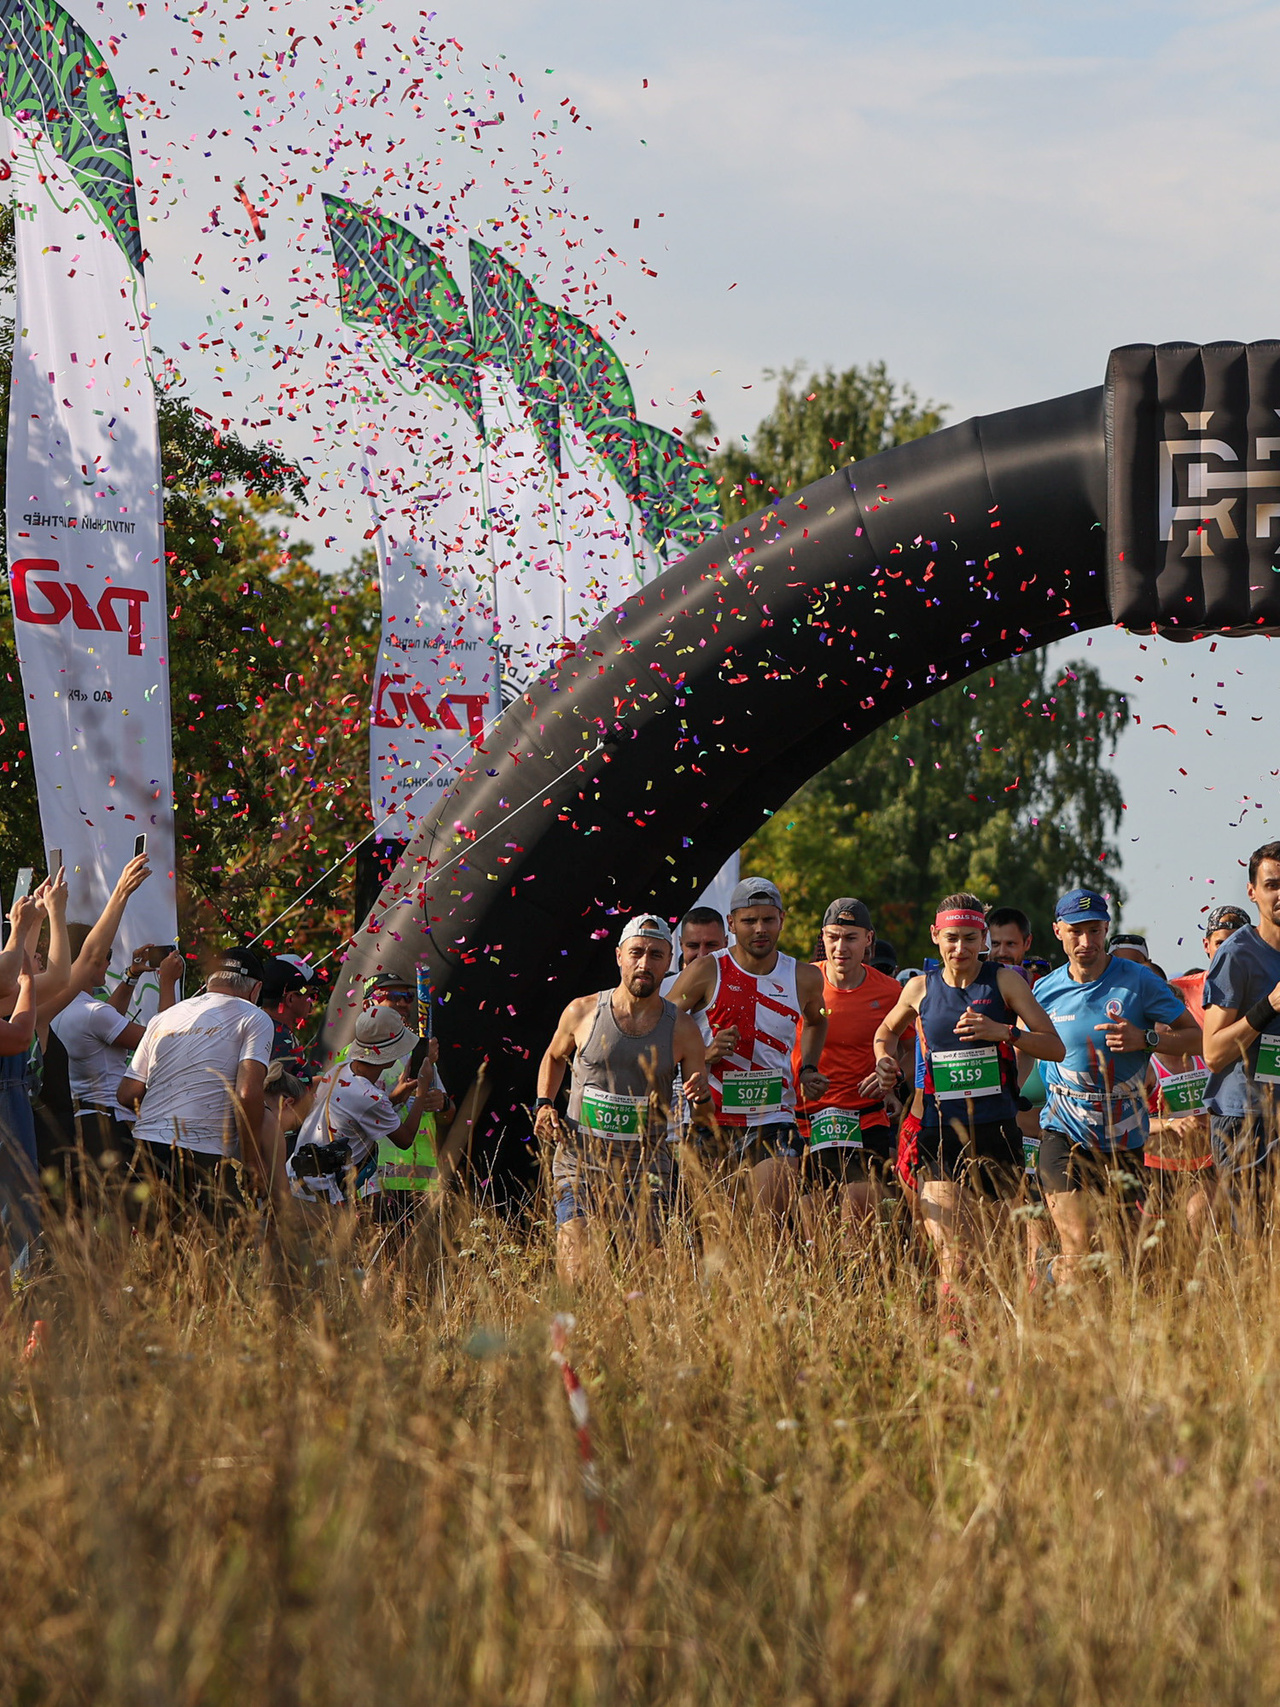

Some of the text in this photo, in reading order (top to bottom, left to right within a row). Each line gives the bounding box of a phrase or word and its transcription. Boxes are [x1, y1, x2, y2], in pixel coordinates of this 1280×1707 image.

[950, 1068, 982, 1083] S159
[738, 1087, 768, 1099] S075
[595, 1110, 629, 1126] S049
[820, 1123, 848, 1136] S082
